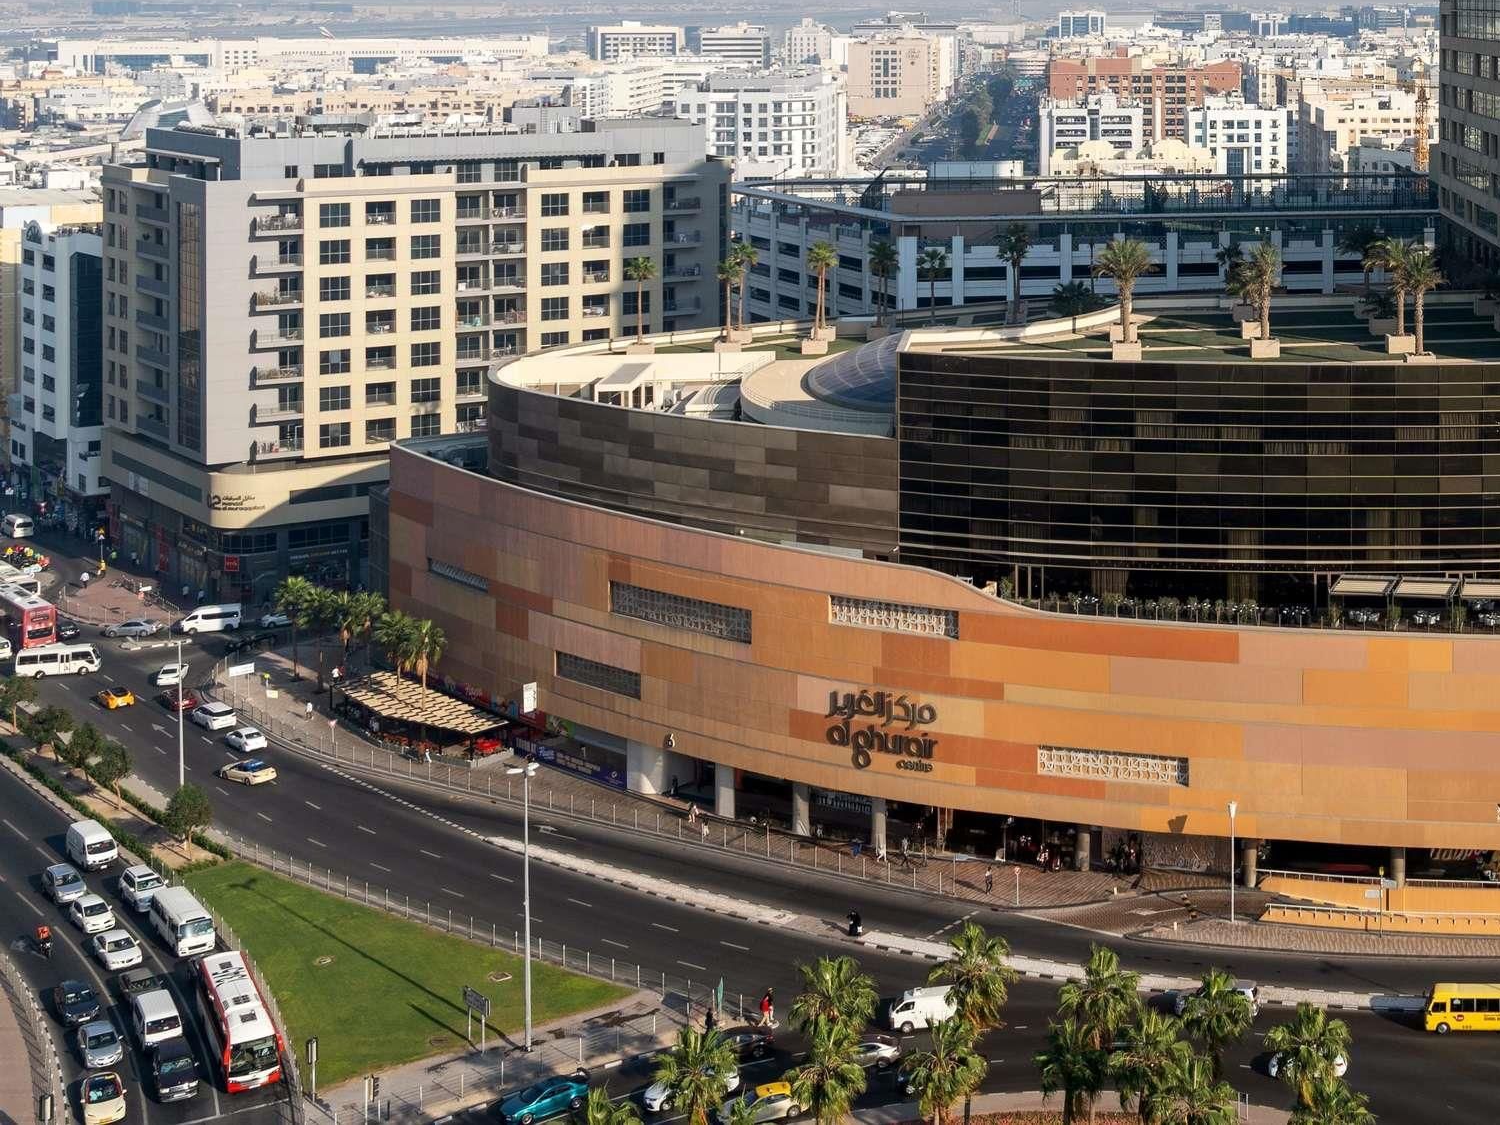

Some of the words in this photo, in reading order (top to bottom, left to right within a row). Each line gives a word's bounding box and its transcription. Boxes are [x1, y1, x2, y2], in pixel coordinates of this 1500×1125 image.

[824, 689, 886, 720] الغرير
[880, 692, 937, 732] مركز
[826, 720, 850, 747] al
[850, 723, 938, 770] ghurair
